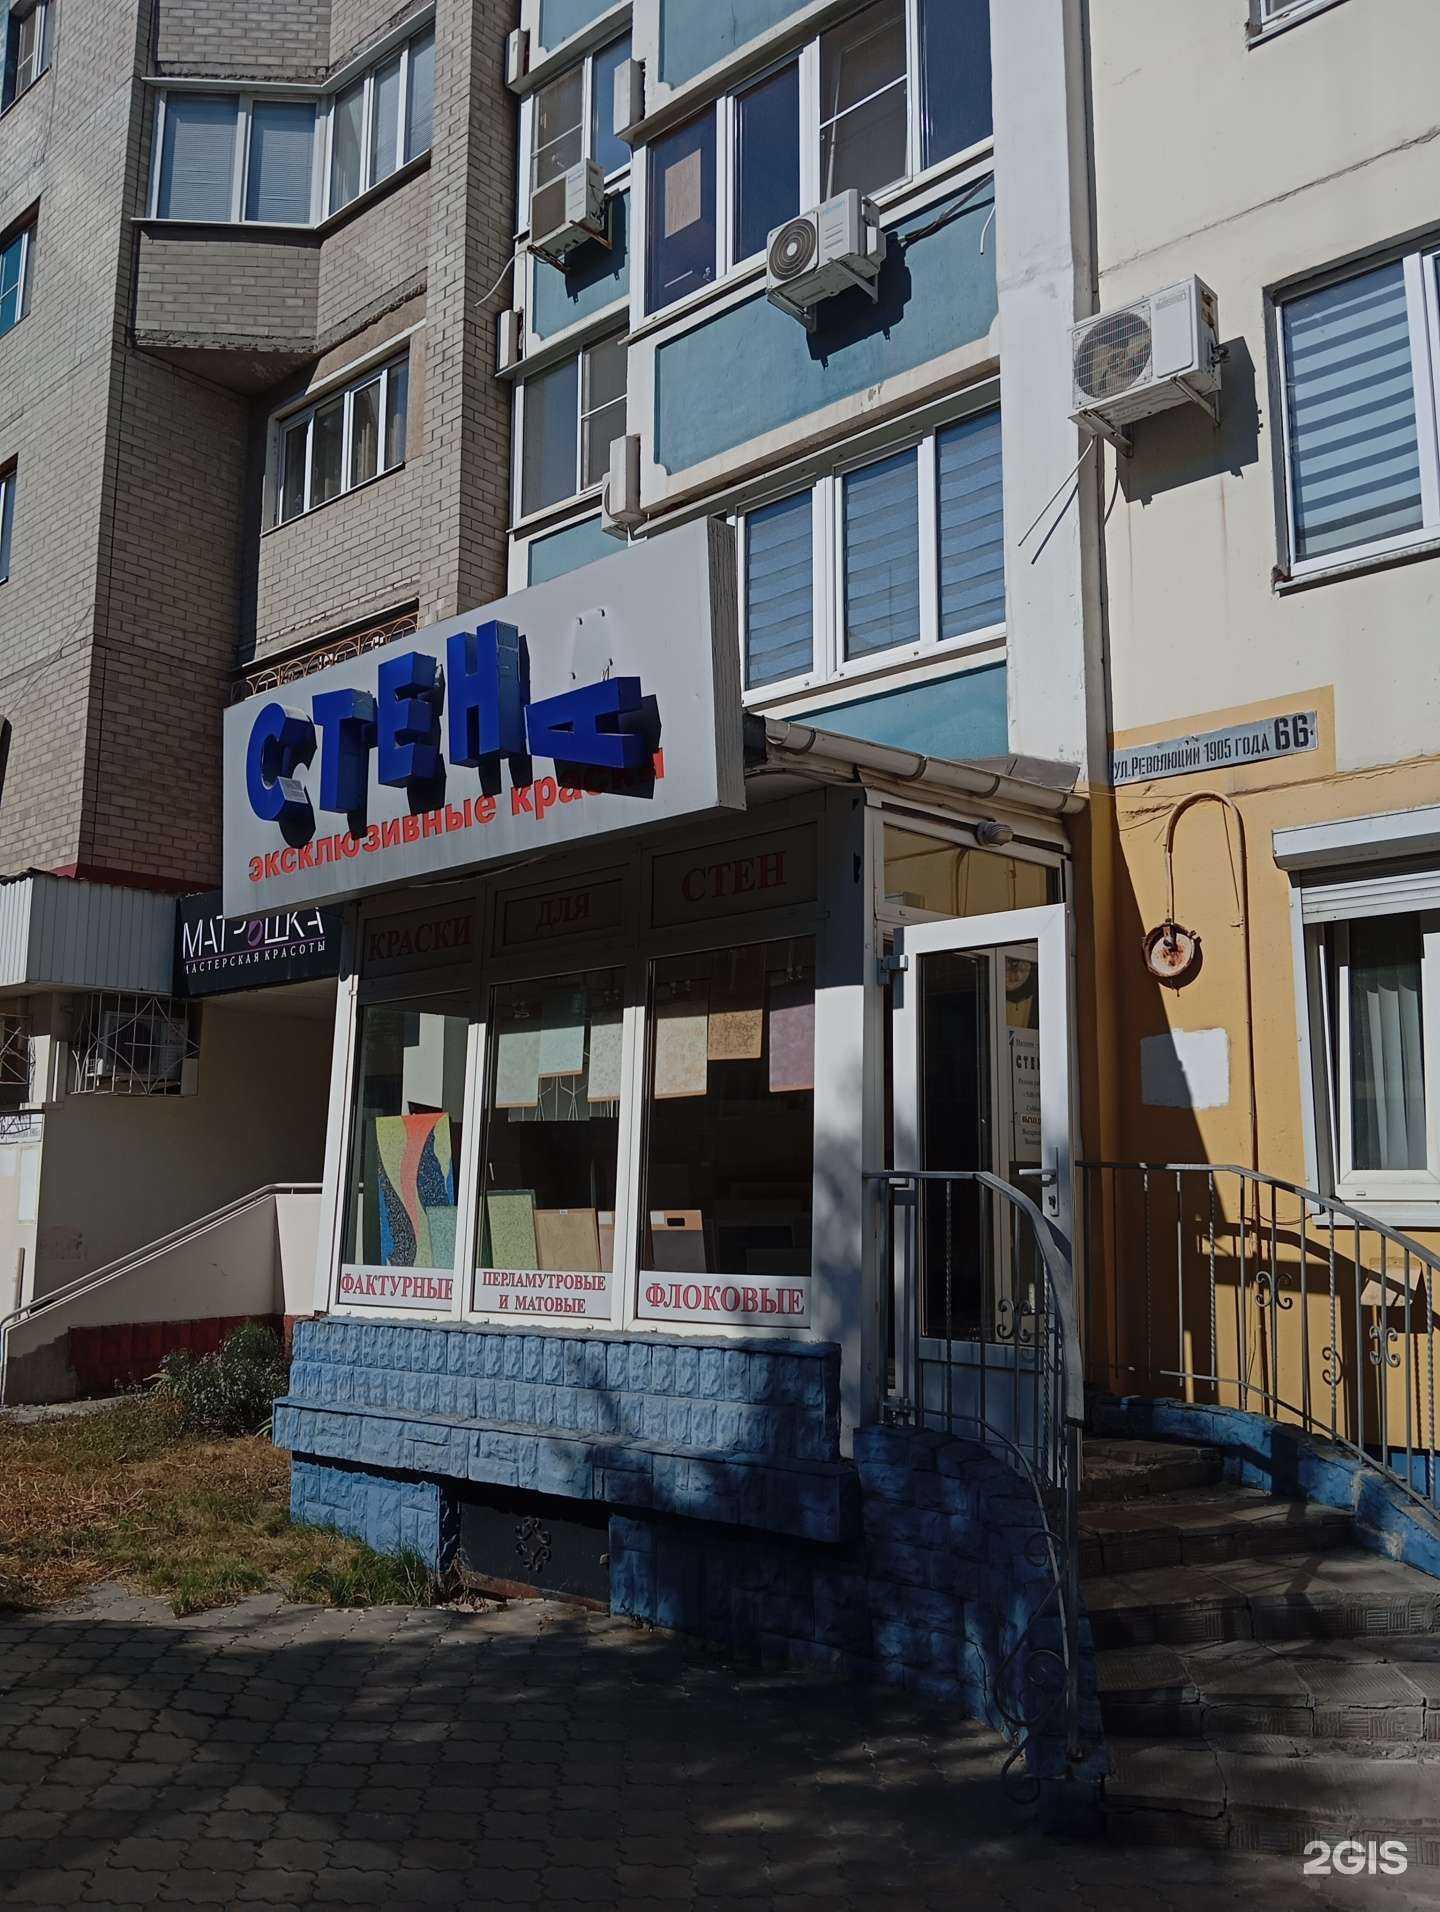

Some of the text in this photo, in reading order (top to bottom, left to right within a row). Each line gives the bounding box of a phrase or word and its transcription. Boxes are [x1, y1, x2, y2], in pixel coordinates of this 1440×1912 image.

[246, 619, 643, 821] СТЕНА
[1204, 738, 1231, 763] 1905
[1235, 733, 1270, 757] ГОДА
[1274, 714, 1309, 750] 66
[248, 794, 497, 882] эксклюзивные
[681, 851, 788, 901] СТЕН
[535, 893, 592, 932] ДЛЯ
[264, 940, 326, 961] КРАСОТЫ
[367, 915, 472, 962] КРАСКИ
[482, 1271, 606, 1291] ПЕРЛАМУТРОВЫЕ
[645, 1283, 805, 1315] ФЛОКОВЫЕ
[499, 1294, 586, 1313] И МАТОВЫЕ
